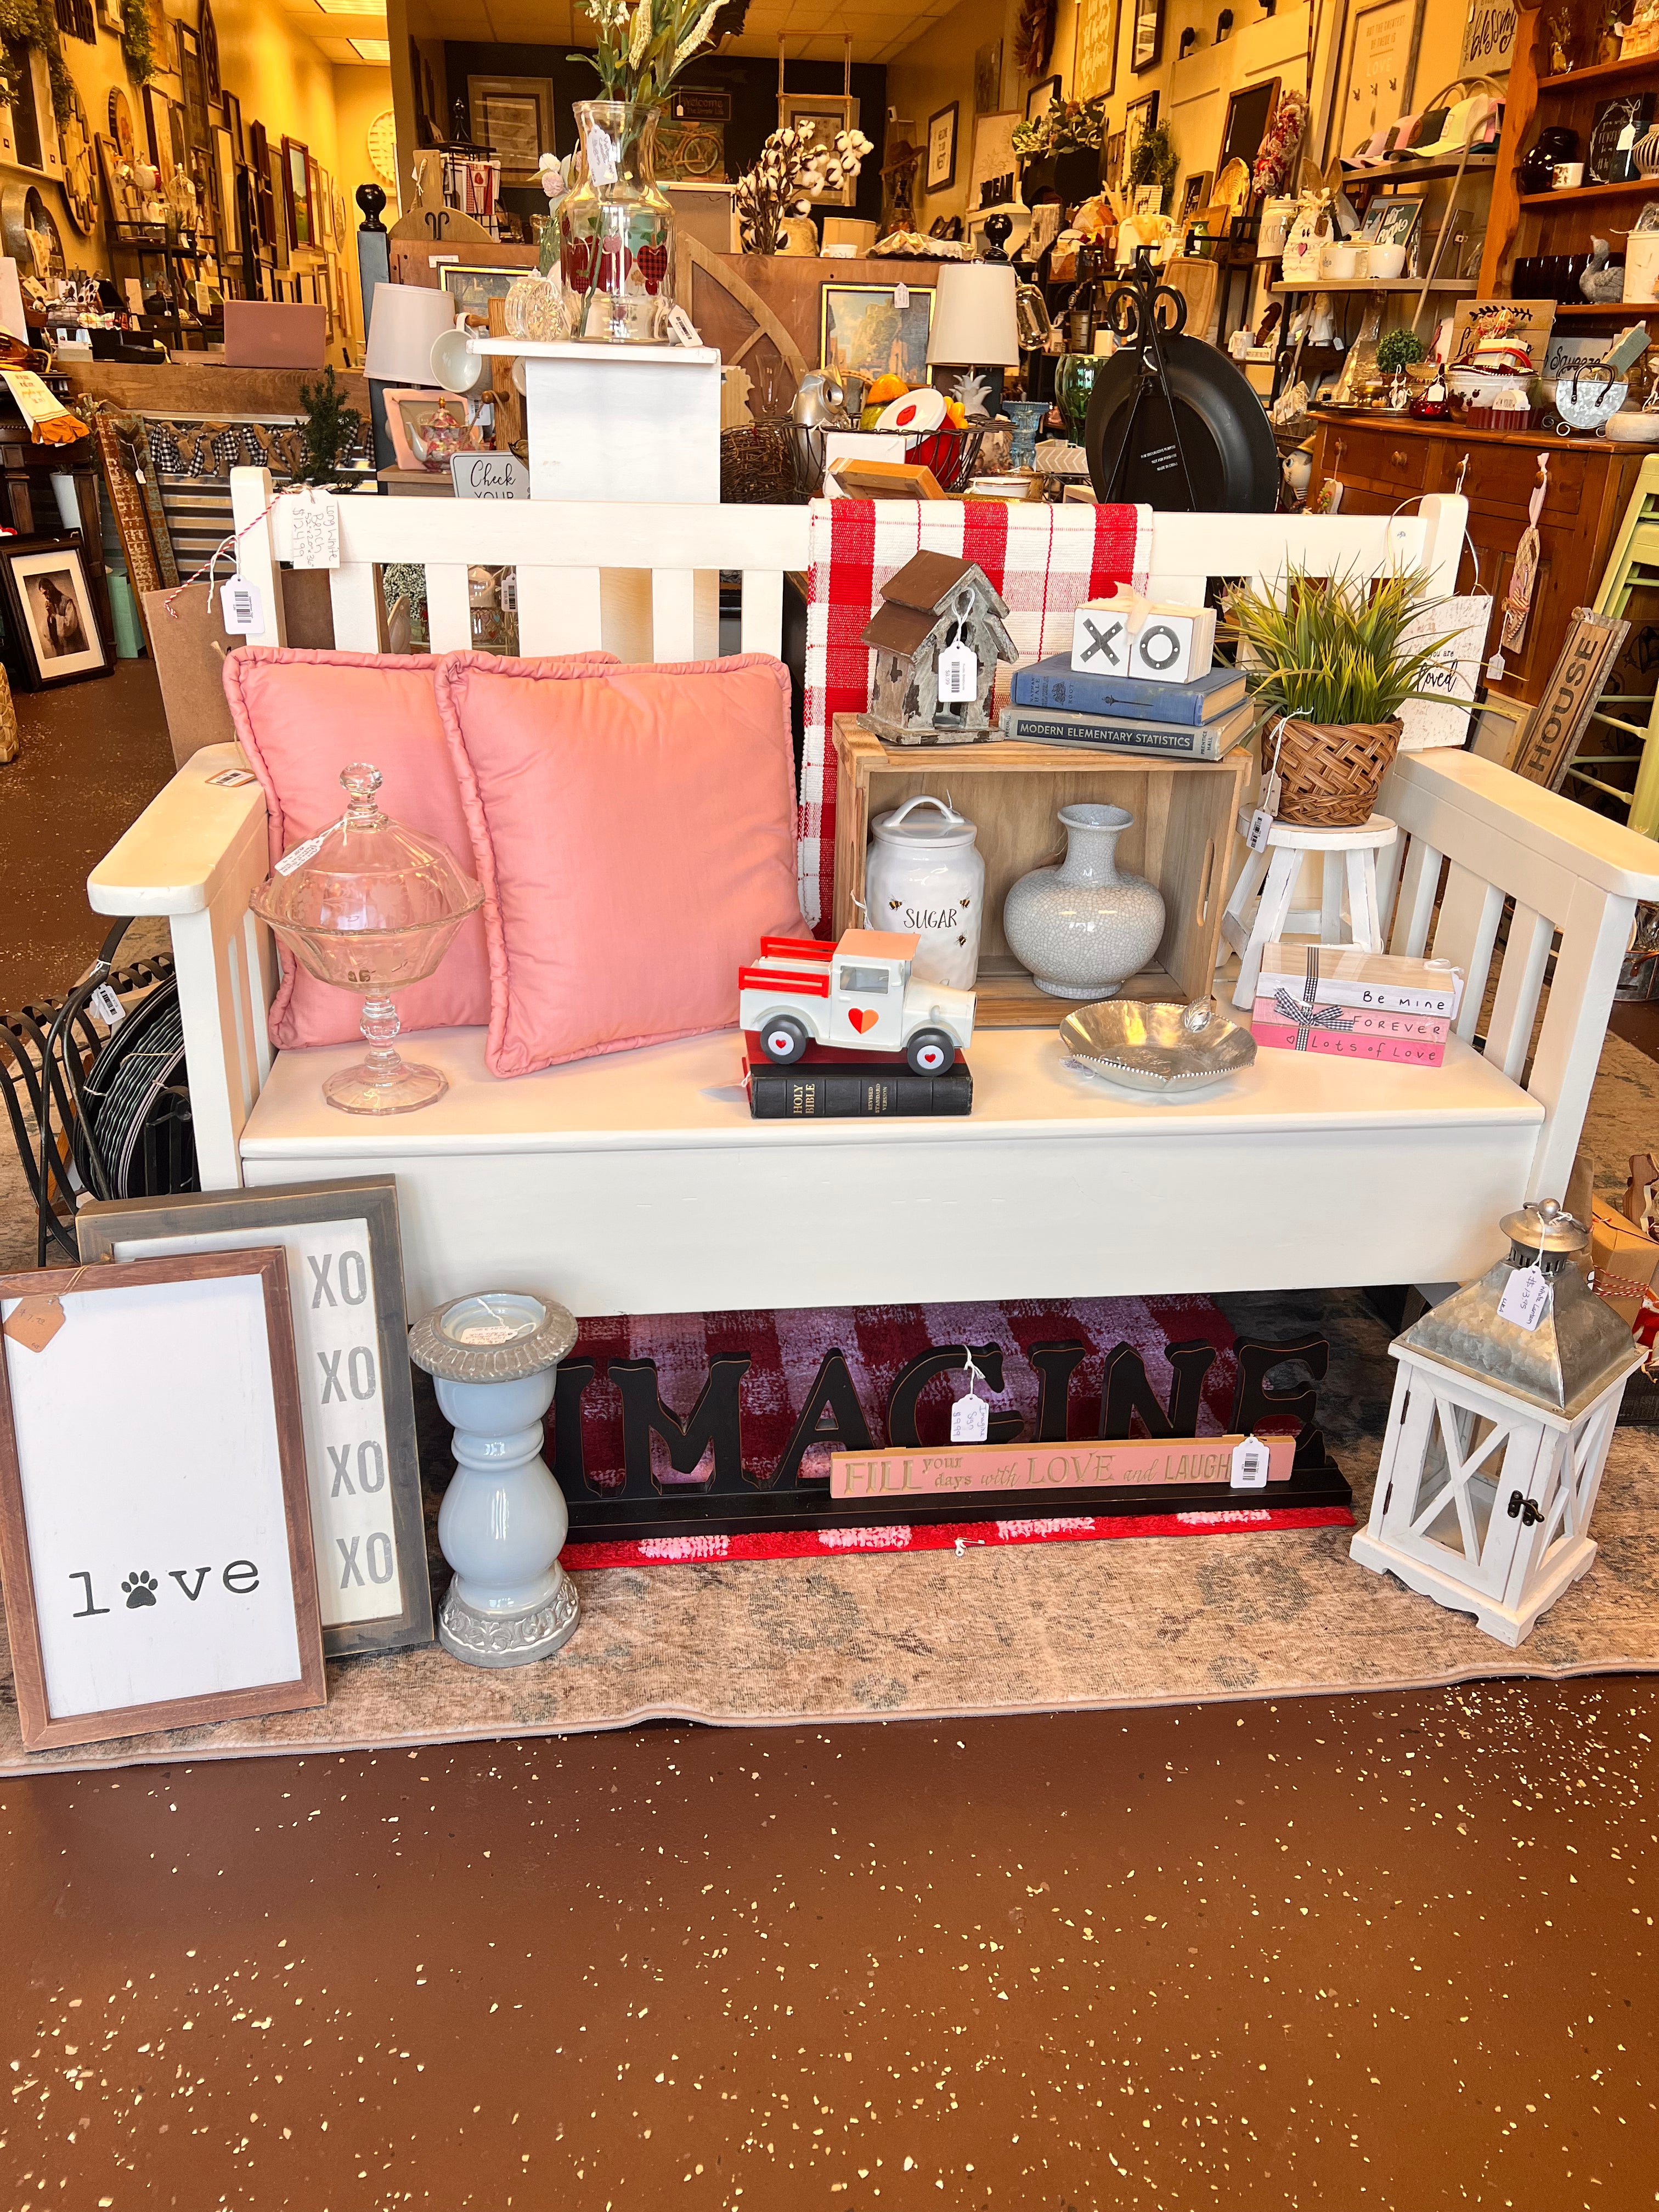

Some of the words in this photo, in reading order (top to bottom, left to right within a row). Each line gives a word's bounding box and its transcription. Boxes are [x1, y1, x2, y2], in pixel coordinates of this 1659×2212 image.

[1366, 57, 1392, 77] LOVE
[471, 460, 516, 487] Check
[323, 505, 335, 527] Long
[311, 512, 325, 554] Bench
[328, 528, 340, 562] White
[1527, 637, 1599, 772] HOUSE
[1020, 723, 1064, 736] MODERN
[1067, 727, 1133, 742] ELEMENTARY
[1135, 734, 1191, 747] STATISTICS
[904, 908, 957, 929] SUGAR
[1363, 991, 1385, 1005] Be
[1353, 1015, 1441, 1035] FOREVER
[1312, 1036, 1357, 1052] Lots
[1368, 1042, 1386, 1058] of
[1393, 1046, 1436, 1061] Love
[793, 1084, 803, 1114] HOLY
[805, 1084, 815, 1114] BIBLE
[307, 1250, 368, 1309] XO
[317, 1345, 376, 1404] XO
[546, 1331, 1330, 1499] IMAGINE
[966, 1411, 978, 1430] Sign
[977, 1403, 988, 1437] Imagine
[326, 1440, 386, 1498] XO
[844, 1458, 923, 1496] FILL
[922, 1457, 962, 1474] your
[934, 1471, 972, 1489] days
[981, 1465, 1020, 1489] with
[1026, 1451, 1118, 1486] LOVE
[1122, 1457, 1158, 1483] and
[335, 1532, 393, 1590] XO
